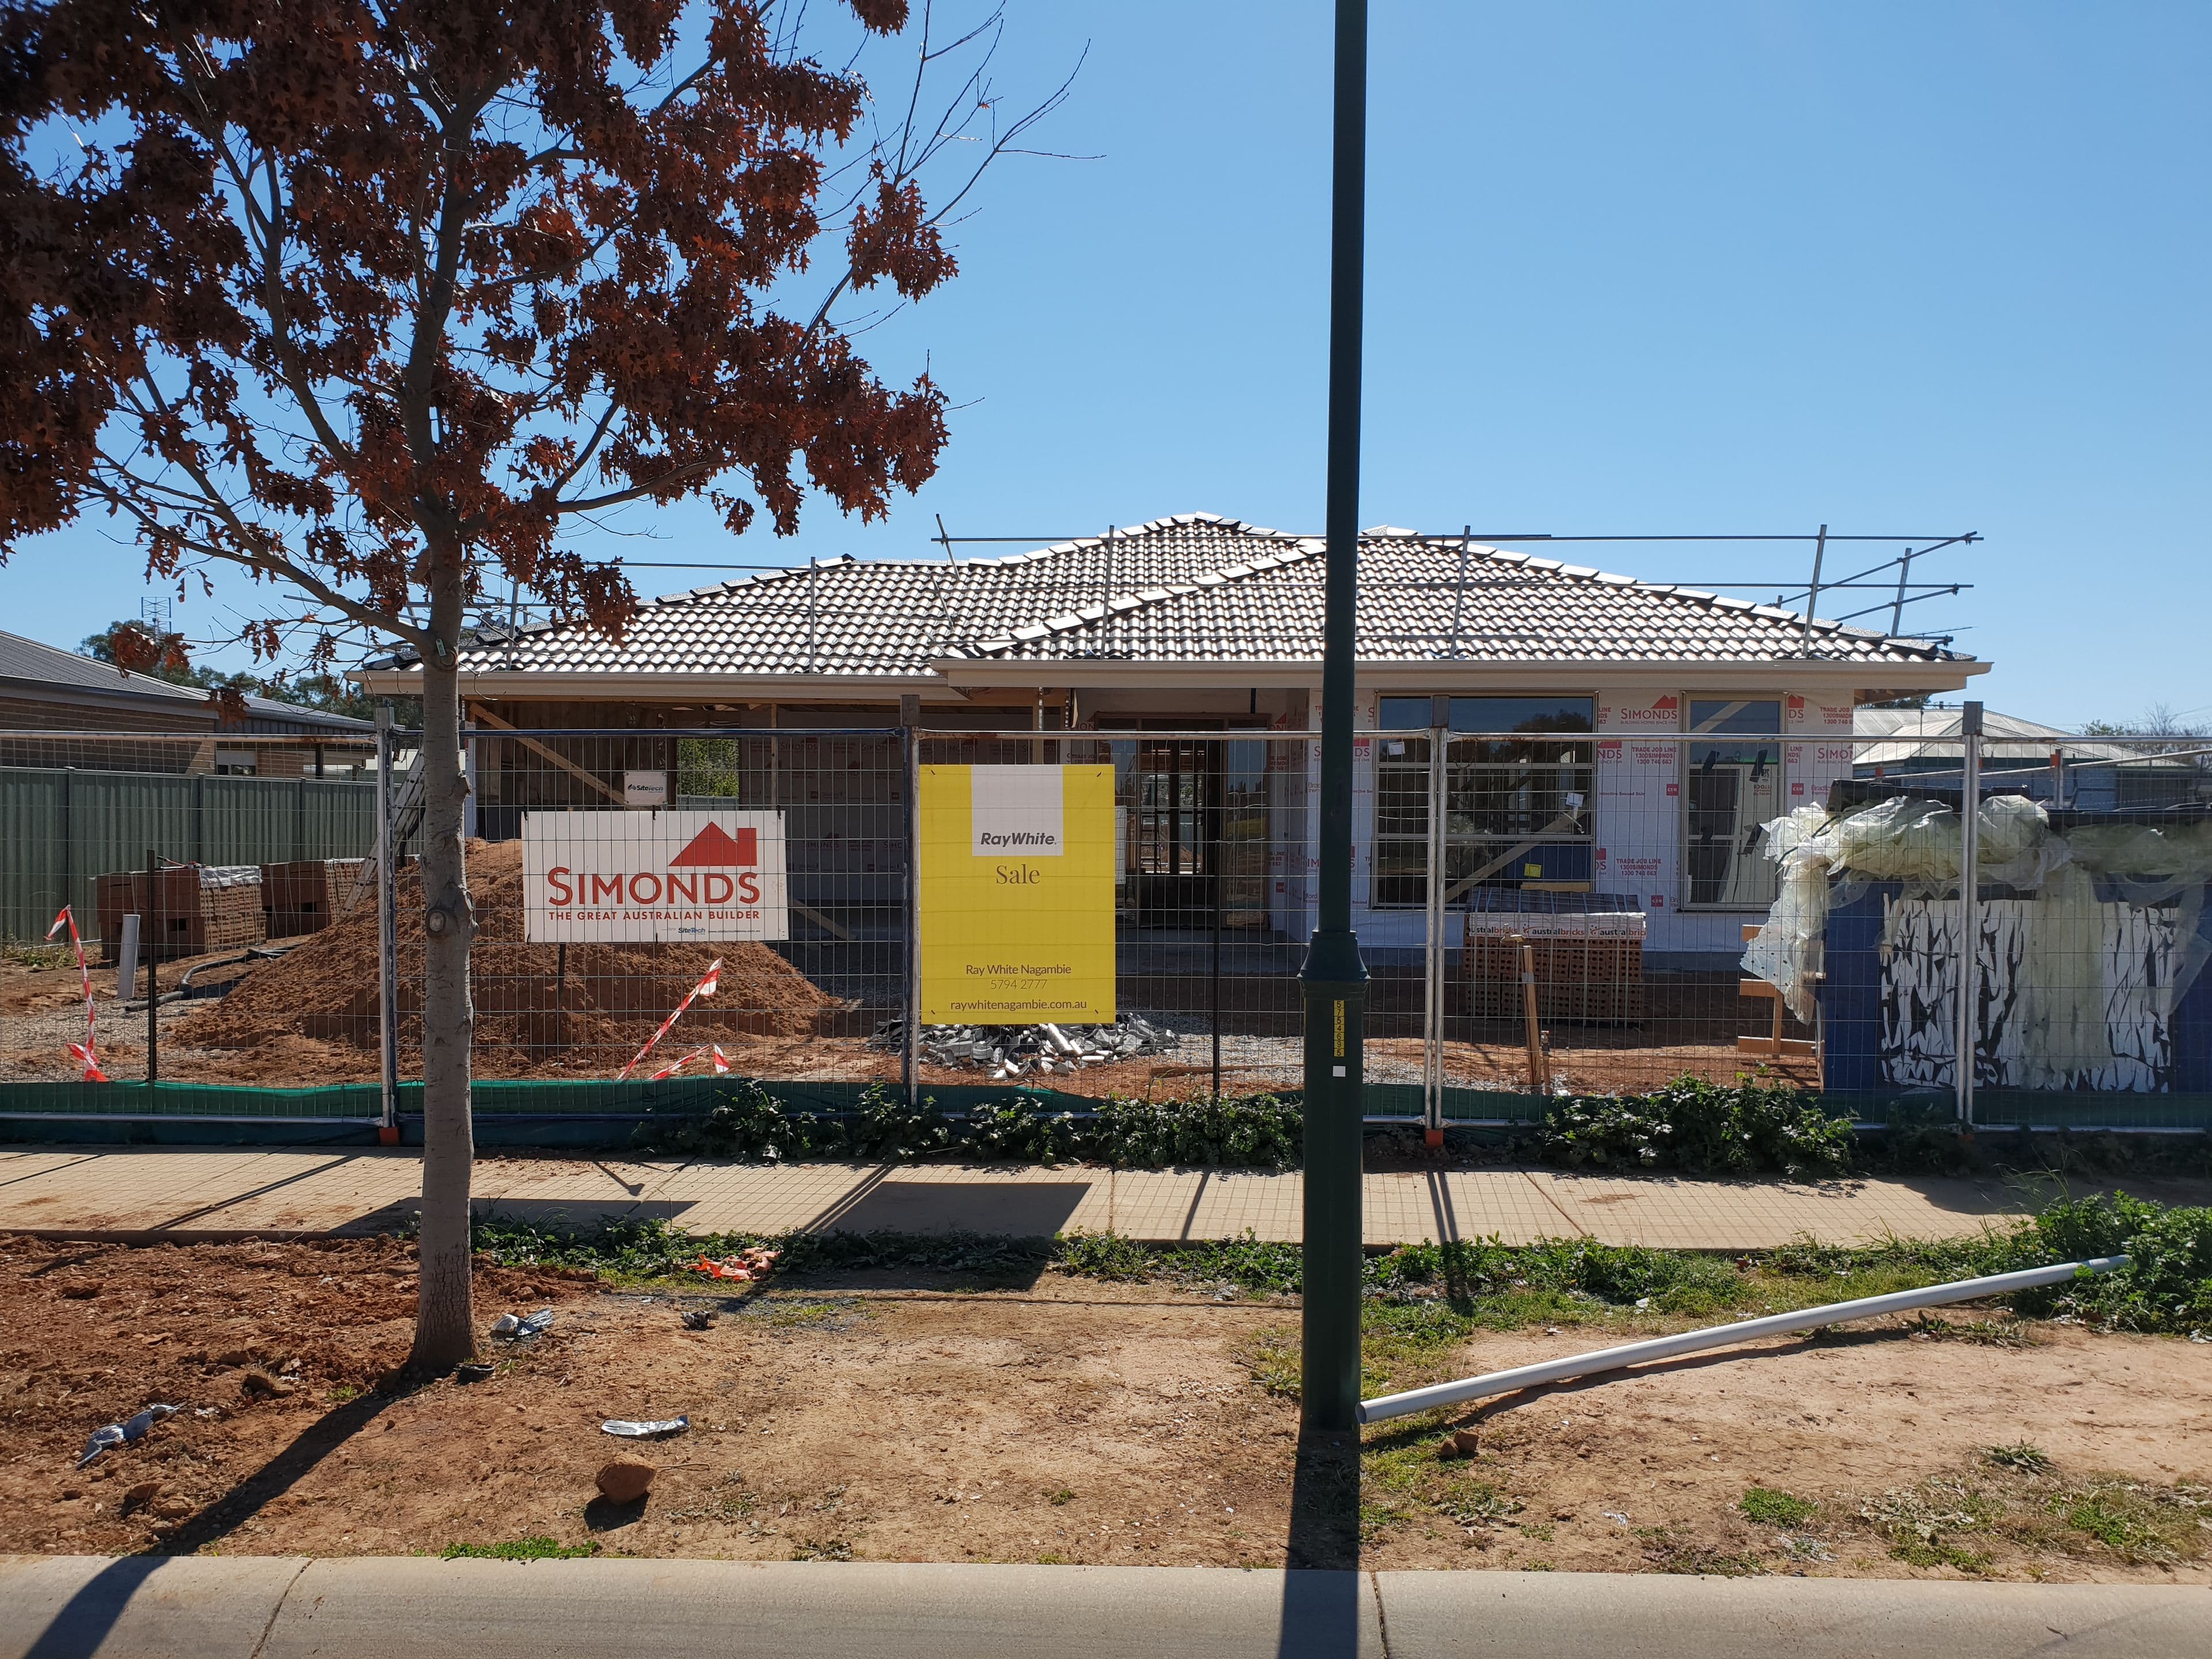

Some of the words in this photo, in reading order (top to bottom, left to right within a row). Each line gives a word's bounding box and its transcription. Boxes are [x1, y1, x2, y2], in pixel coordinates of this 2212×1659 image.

[1621, 709, 1677, 719] SIMONDS
[995, 863, 1041, 885] Sale
[547, 866, 760, 906] SIMONDS
[549, 911, 572, 921] THE
[577, 911, 618, 921] GREAT
[623, 911, 703, 920] AUSTRALIAN
[709, 910, 760, 920] BUILDER
[966, 964, 985, 976] Ray
[987, 964, 1019, 975] White
[1021, 964, 1071, 976] Nagambie
[990, 979, 1017, 990] 5794
[1020, 979, 1048, 990] 2777
[950, 999, 1088, 1012] raywhitenagambie.com.au
